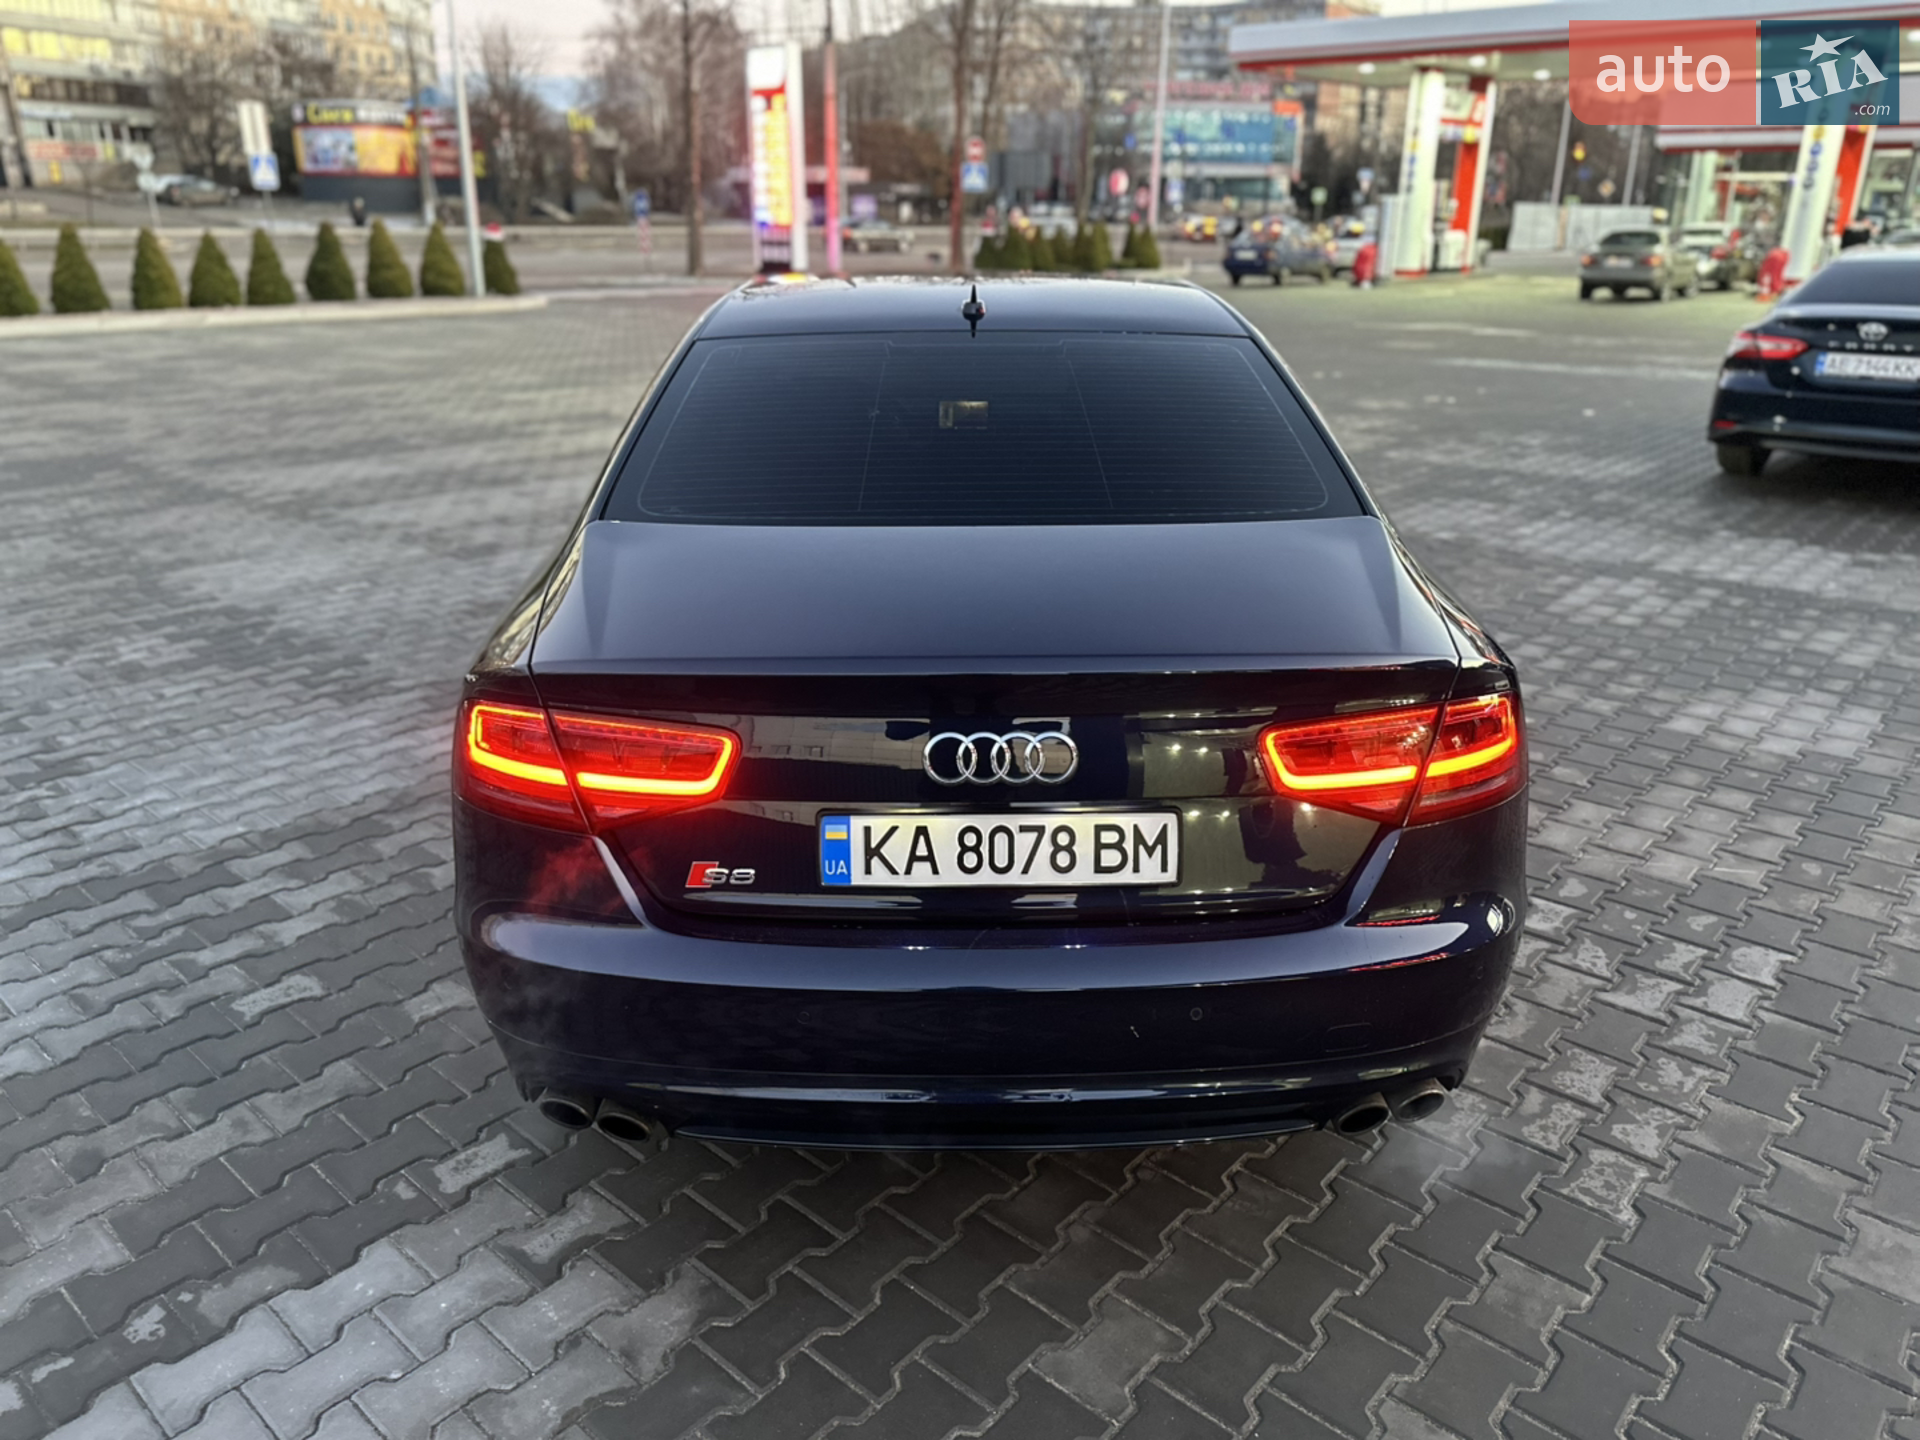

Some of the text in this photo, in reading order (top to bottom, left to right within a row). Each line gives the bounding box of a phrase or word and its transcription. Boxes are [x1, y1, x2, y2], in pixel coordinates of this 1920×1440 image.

[863, 823, 1169, 876] KA 8078 BM
[824, 859, 849, 876] UA
[702, 868, 756, 885] S8
